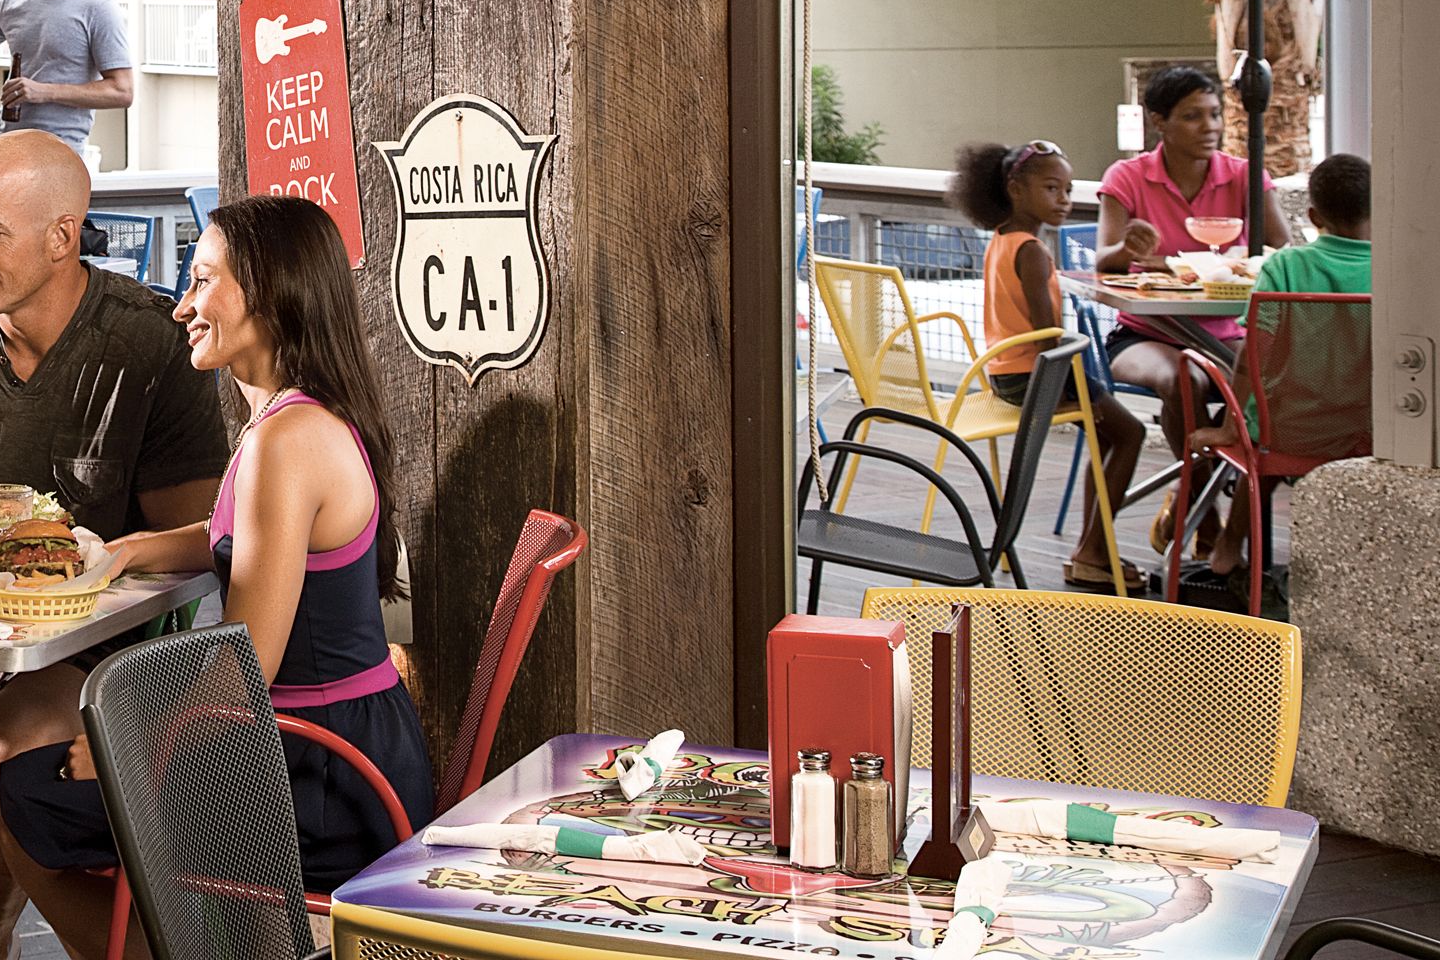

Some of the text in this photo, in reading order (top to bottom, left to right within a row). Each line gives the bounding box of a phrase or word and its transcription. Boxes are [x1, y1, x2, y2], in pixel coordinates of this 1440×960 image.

[266, 70, 324, 114] KEEP
[265, 107, 329, 150] CALM
[289, 155, 311, 172] AND
[410, 163, 519, 205] COSTA RICA
[418, 866, 787, 926] BEACH
[472, 901, 840, 957] BURGERS PIZZA
